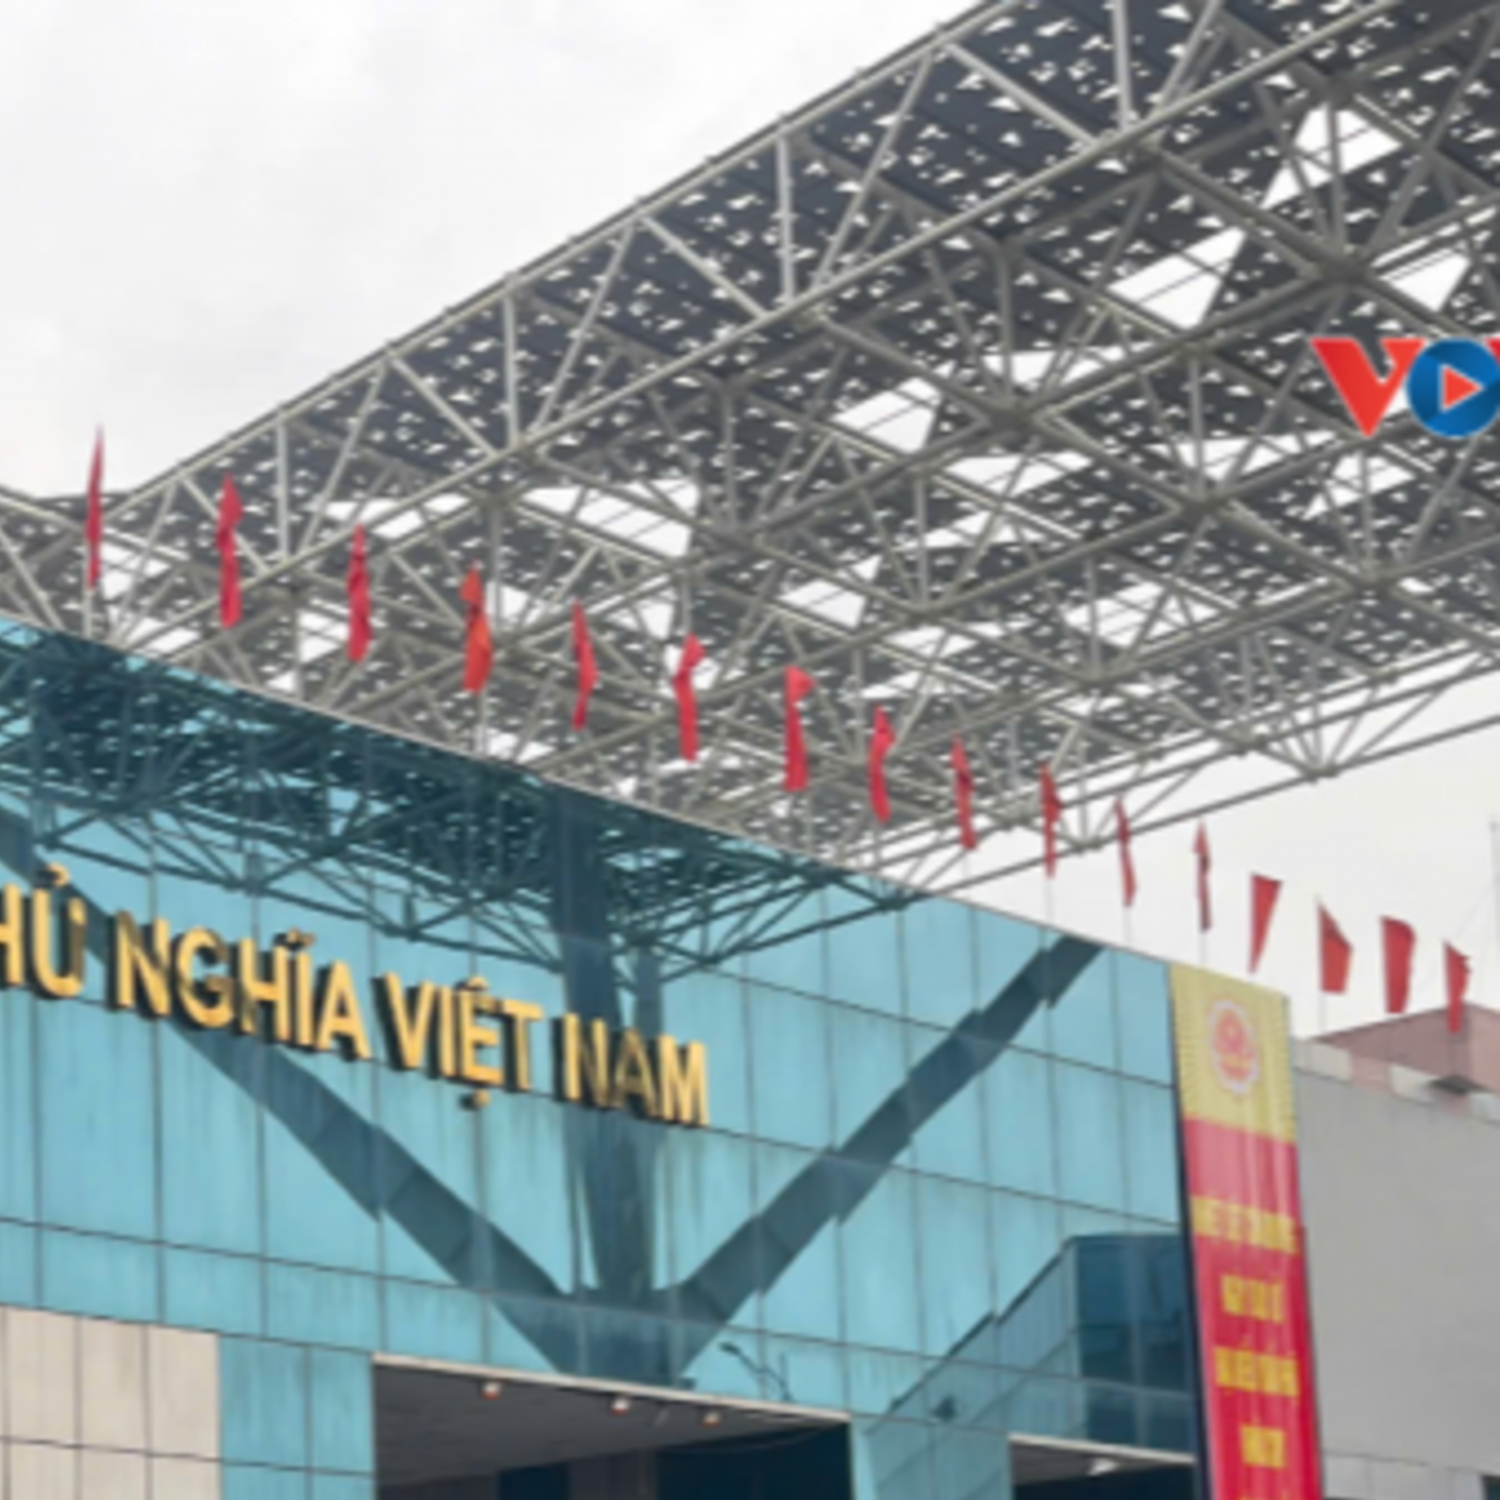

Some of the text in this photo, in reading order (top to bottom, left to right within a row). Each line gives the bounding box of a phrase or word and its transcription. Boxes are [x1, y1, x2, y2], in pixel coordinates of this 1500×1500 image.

[115, 910, 371, 1060] NGHĨA
[385, 972, 543, 1110] VIỆT
[563, 1012, 709, 1126] NAM
